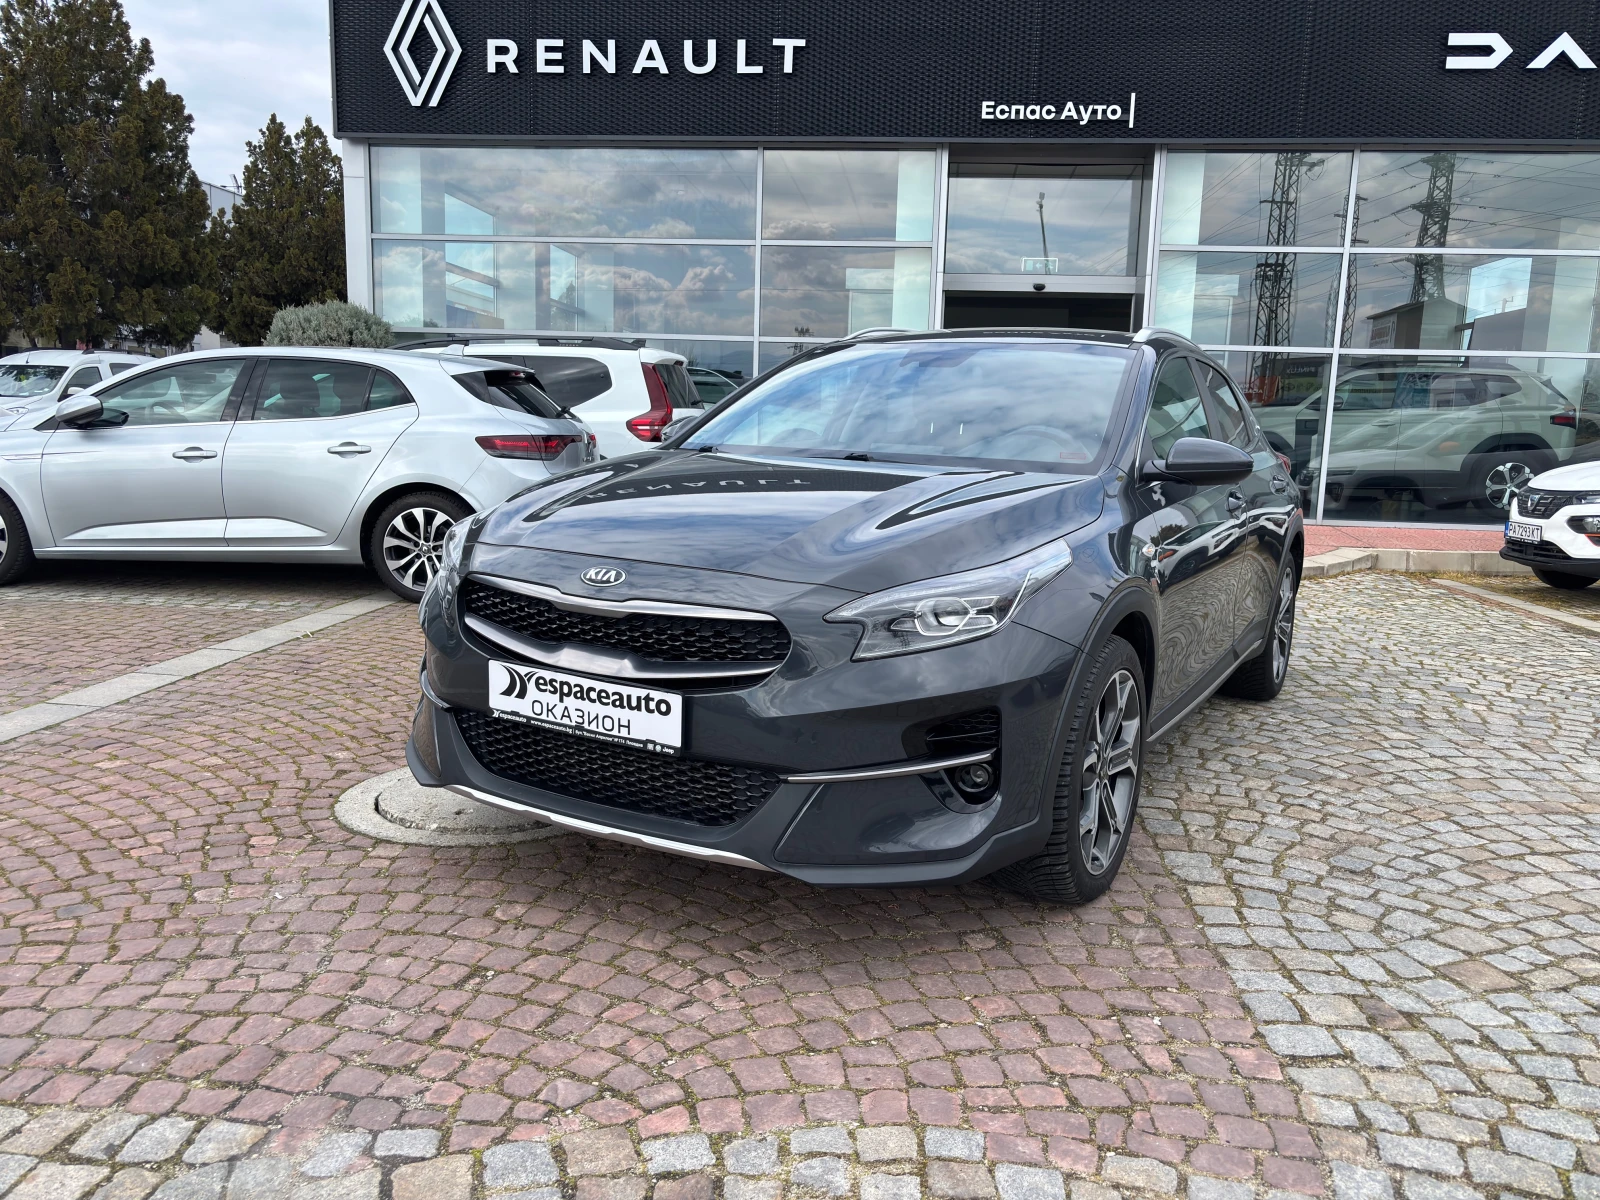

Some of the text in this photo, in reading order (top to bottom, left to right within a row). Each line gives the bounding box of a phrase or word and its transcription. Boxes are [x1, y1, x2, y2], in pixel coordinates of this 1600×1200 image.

[486, 38, 806, 75] RENAULT
[980, 100, 1122, 125] Еспас Ауто
[585, 567, 618, 583] KIA
[534, 675, 671, 716] espaceauto
[499, 712, 527, 723] espaceauto
[531, 699, 631, 736] ОКАЗИОН
[662, 746, 675, 755] Jeep
